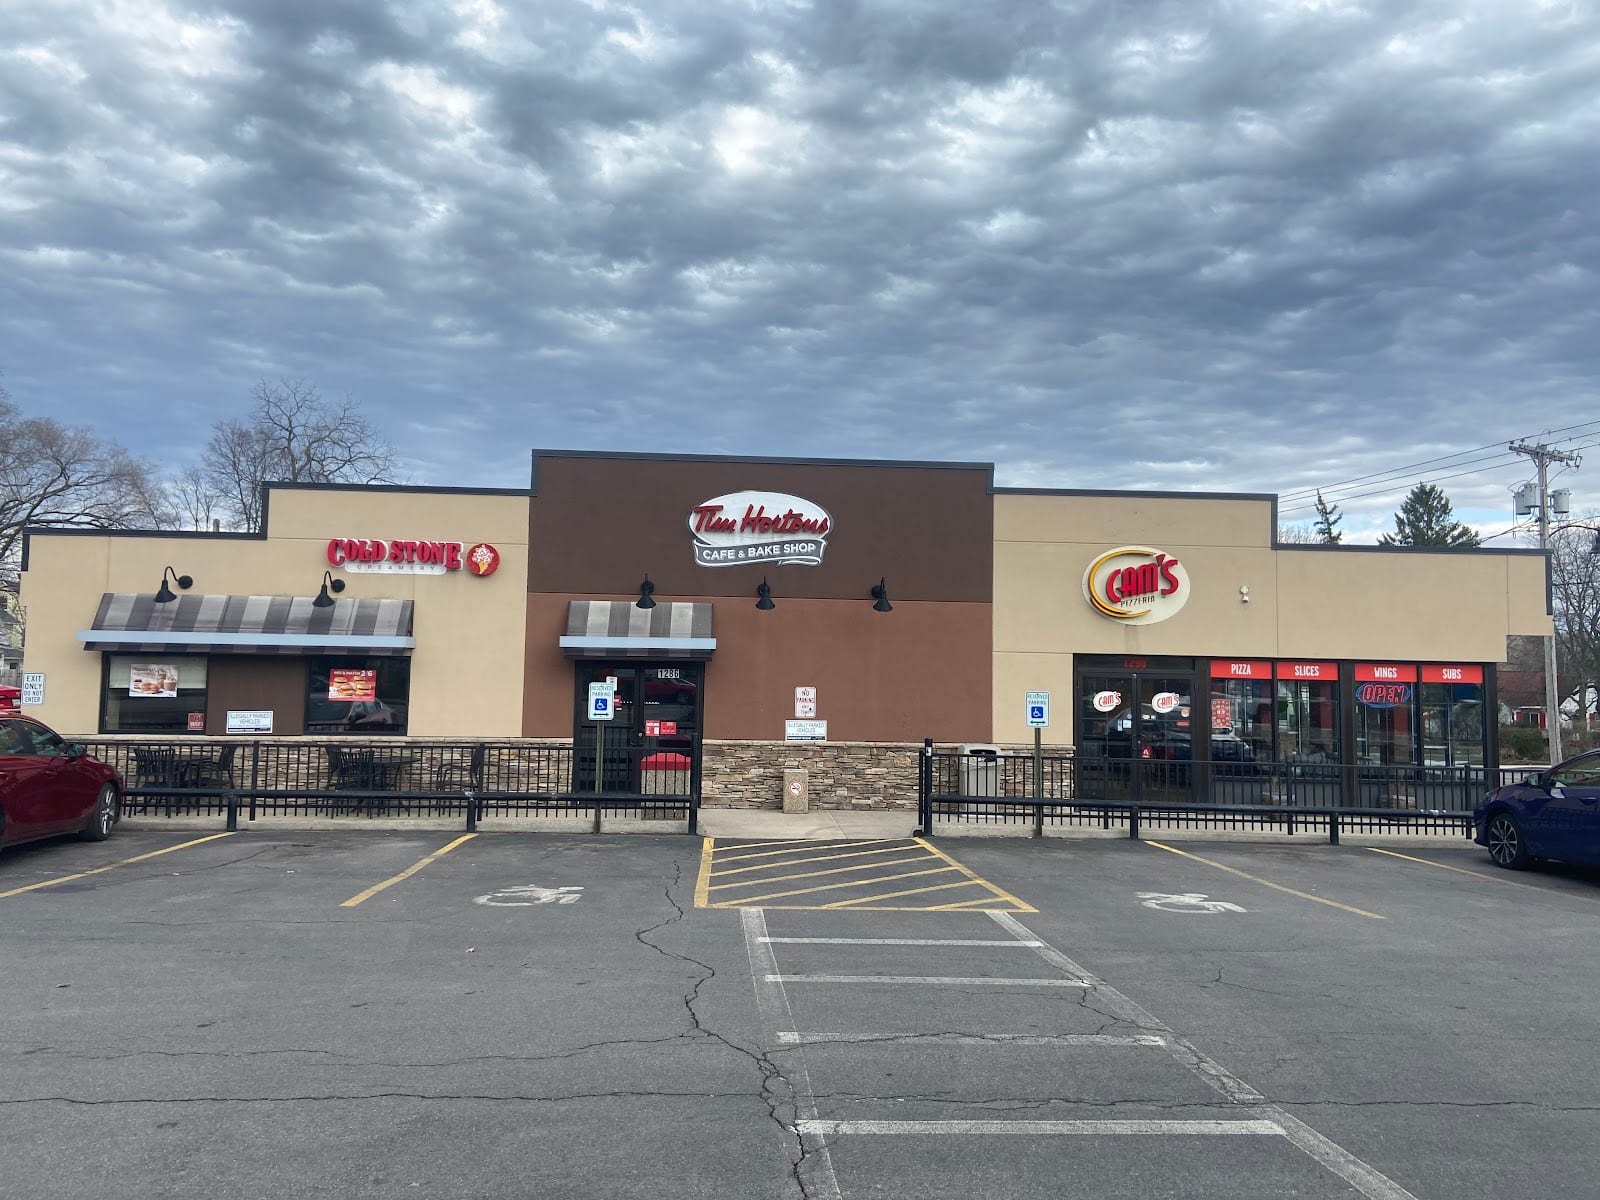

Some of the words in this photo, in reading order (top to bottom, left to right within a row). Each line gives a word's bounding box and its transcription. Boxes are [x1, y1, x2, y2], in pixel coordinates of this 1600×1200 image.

[694, 504, 737, 534] Tim
[740, 503, 829, 534] Hortons
[327, 538, 386, 567] COLD
[389, 540, 462, 569] STONE
[702, 549, 736, 560] CAFE
[738, 550, 746, 558] &
[747, 544, 781, 557] BAKE
[783, 542, 817, 554] SHOP
[356, 564, 436, 572] CREAMERY
[1105, 553, 1179, 604] CAM'S
[1120, 595, 1155, 607] PIZZERIA
[658, 669, 679, 678] 1286
[1231, 663, 1252, 675] PIZZA
[1294, 665, 1320, 677] SLICES
[1373, 666, 1398, 678] WINGS
[1442, 668, 1462, 680] SUBS
[24, 682, 42, 690] ONLY
[1362, 684, 1405, 703] OPEN
